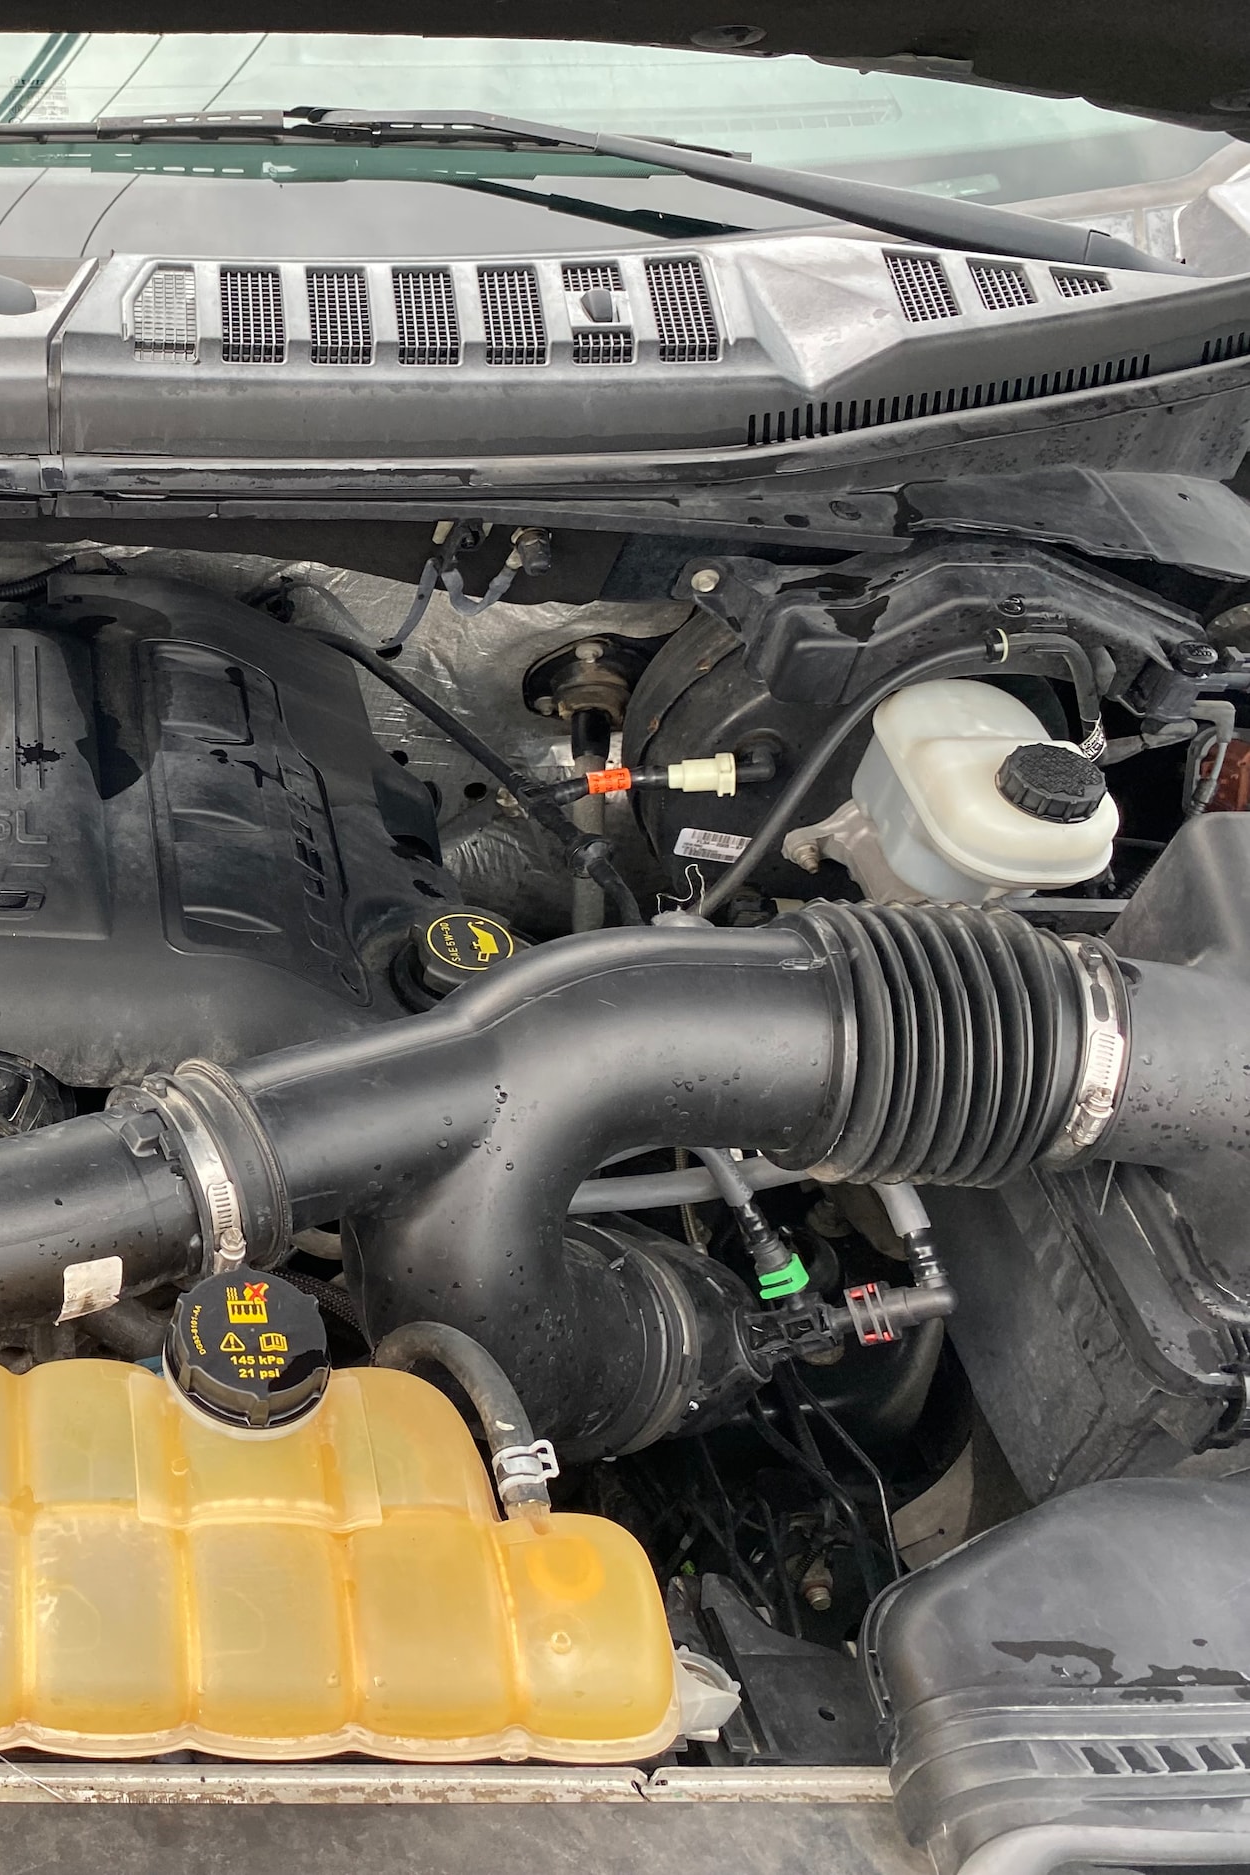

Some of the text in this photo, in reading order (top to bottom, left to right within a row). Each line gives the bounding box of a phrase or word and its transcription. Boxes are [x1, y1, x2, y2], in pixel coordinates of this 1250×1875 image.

[439, 922, 461, 962] SAE 5W-30
[230, 1355, 285, 1365] 145 kPa
[238, 1368, 280, 1380] 21 psi
